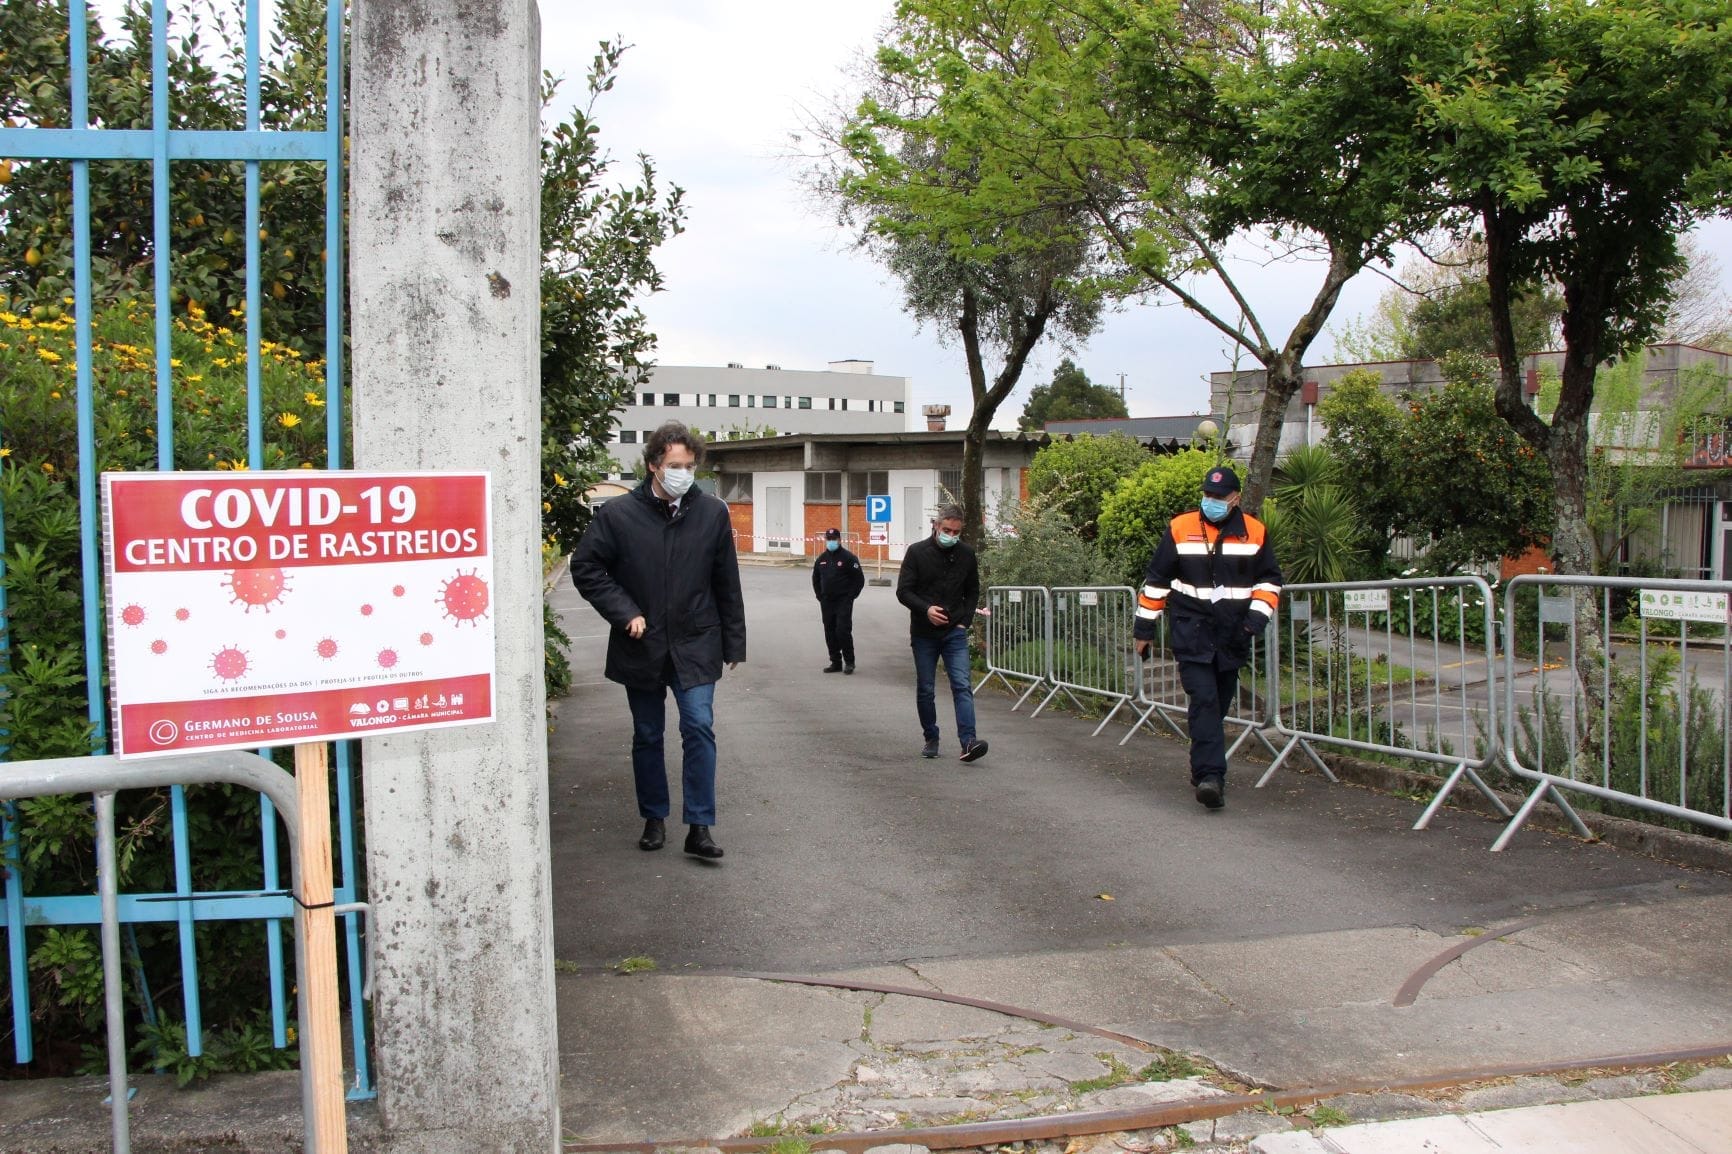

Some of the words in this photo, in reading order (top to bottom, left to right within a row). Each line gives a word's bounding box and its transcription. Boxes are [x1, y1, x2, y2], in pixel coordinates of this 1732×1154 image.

[181, 485, 416, 529] COVID-19
[871, 497, 887, 520] P
[125, 535, 257, 566] CENTRO
[269, 532, 308, 560] DE
[320, 527, 478, 558] RASTREIOS
[1641, 608, 1674, 617] VALONGO
[231, 681, 288, 692] RECOMENDAÇÕES
[320, 676, 355, 685] PROTEJA-SE
[363, 673, 388, 681] PROTEJA
[184, 717, 251, 732] GERMANO
[256, 715, 272, 726] DE
[276, 711, 318, 724] SOUSA
[350, 714, 397, 727] VALONGO
[402, 712, 429, 721] CÂMARA
[431, 709, 464, 718] MUNICIPAL
[185, 733, 214, 741] CENTRO
[229, 729, 265, 737] MEDICINA
[267, 723, 319, 734] LABORATORIAL
